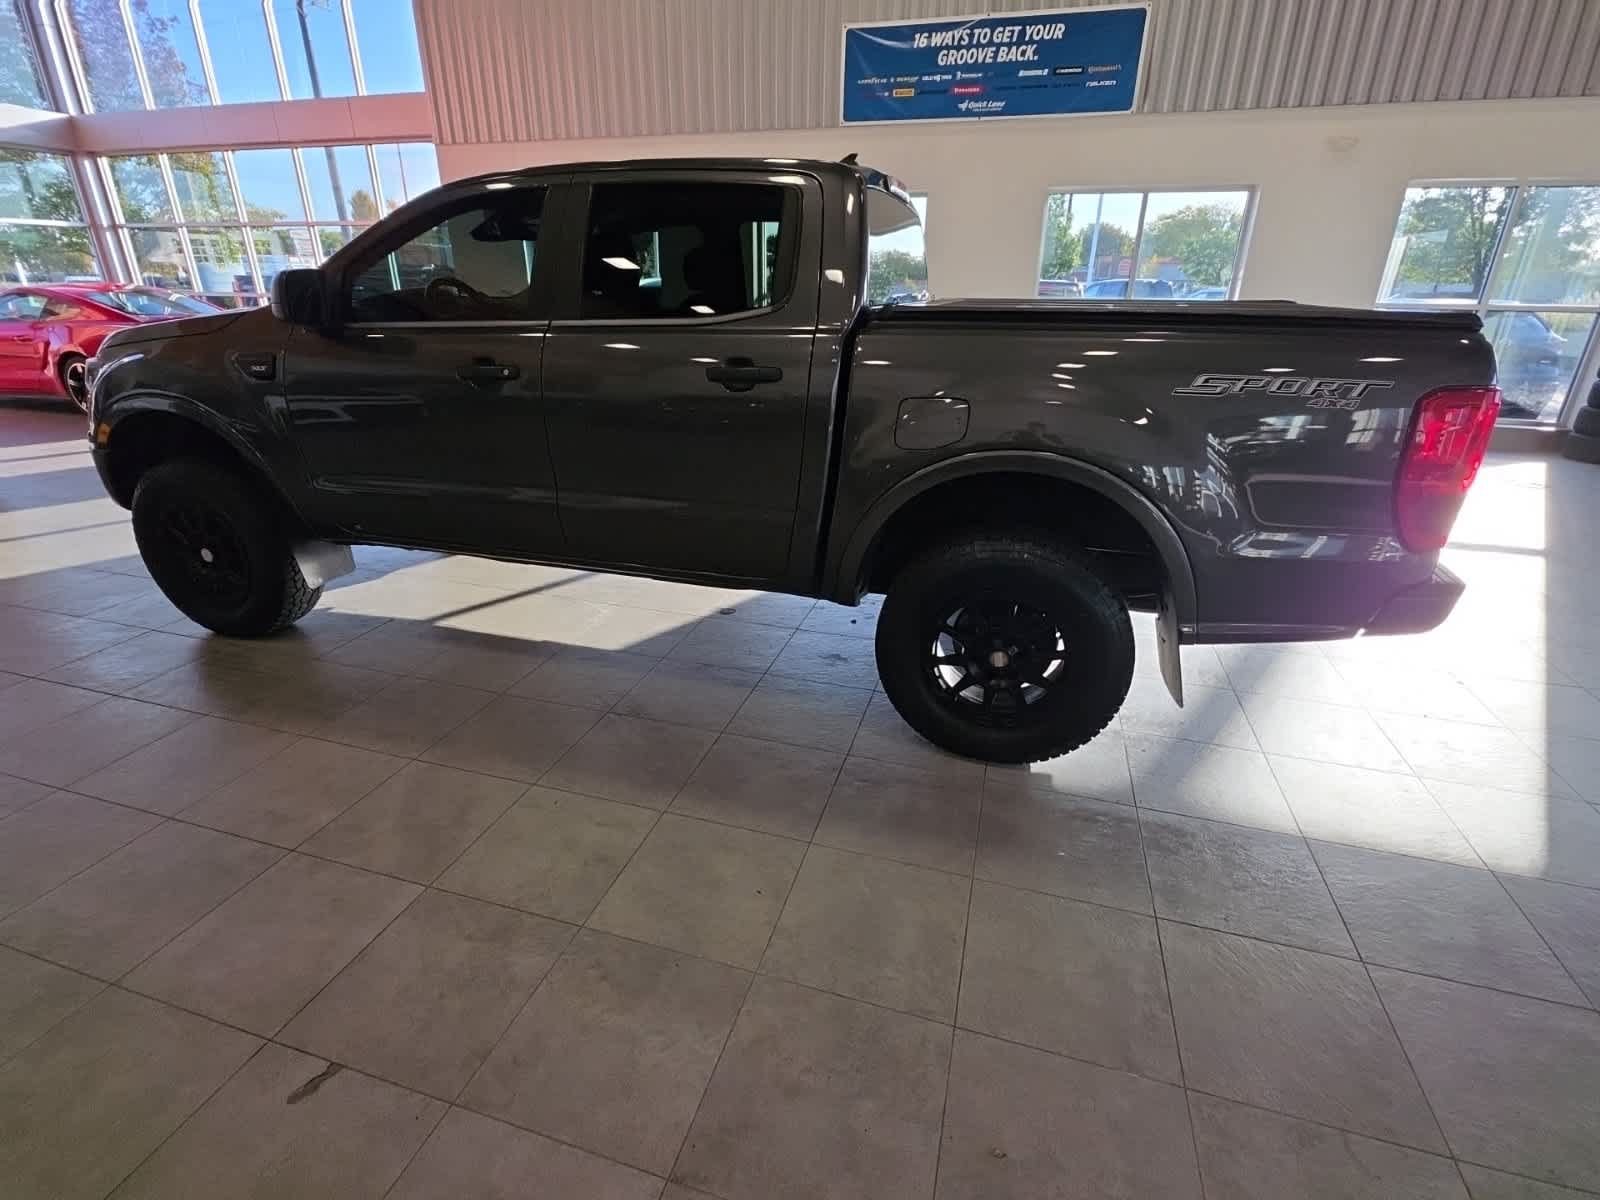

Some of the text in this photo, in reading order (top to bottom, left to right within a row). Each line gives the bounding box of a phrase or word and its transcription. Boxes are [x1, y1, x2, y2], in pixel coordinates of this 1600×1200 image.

[913, 23, 1065, 48] 16 WAYS TO GET YOUR
[937, 44, 1039, 65] GROOVE BACK.
[1171, 373, 1395, 399] SPORT
